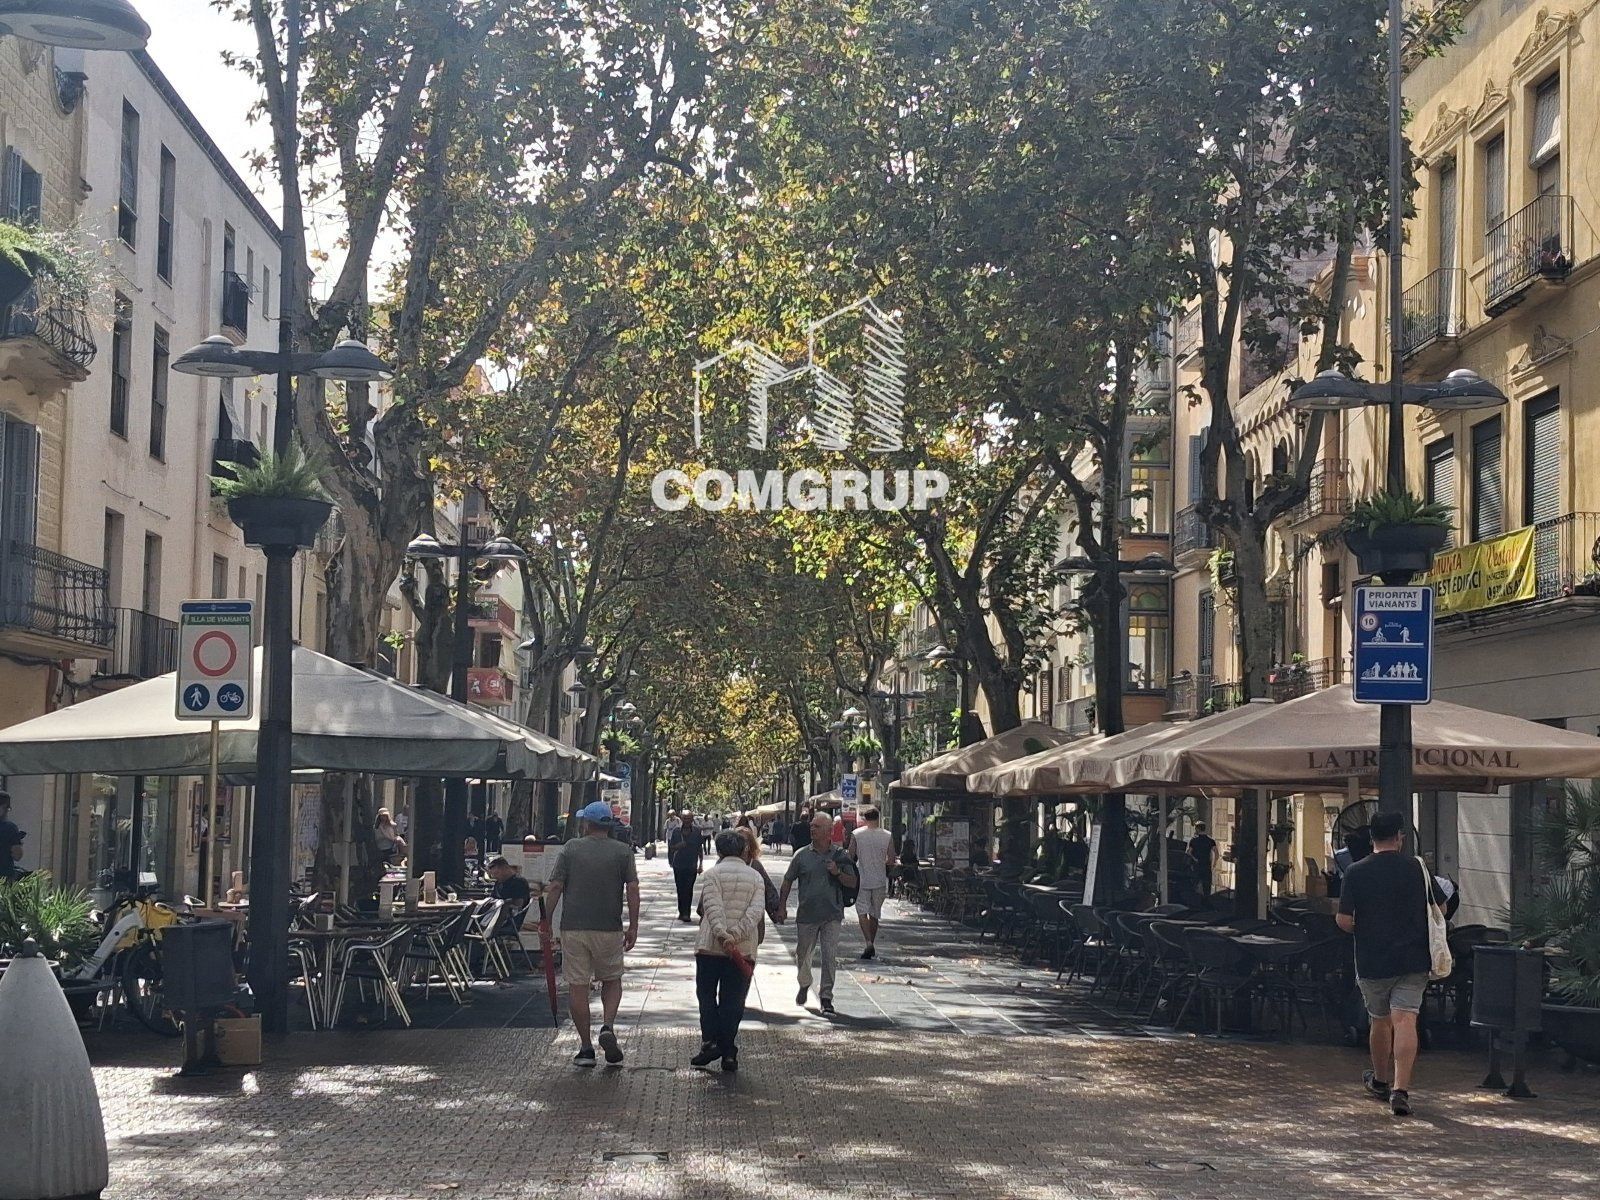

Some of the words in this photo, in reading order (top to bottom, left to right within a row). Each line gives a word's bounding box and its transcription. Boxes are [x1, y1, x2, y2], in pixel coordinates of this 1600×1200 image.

[1368, 591, 1417, 599] PRIORITAT
[1369, 600, 1417, 608] VIANANTS
[1365, 618, 1375, 626] 10
[1307, 751, 1341, 769] LA
[1345, 748, 1520, 769] TRICIONAL
